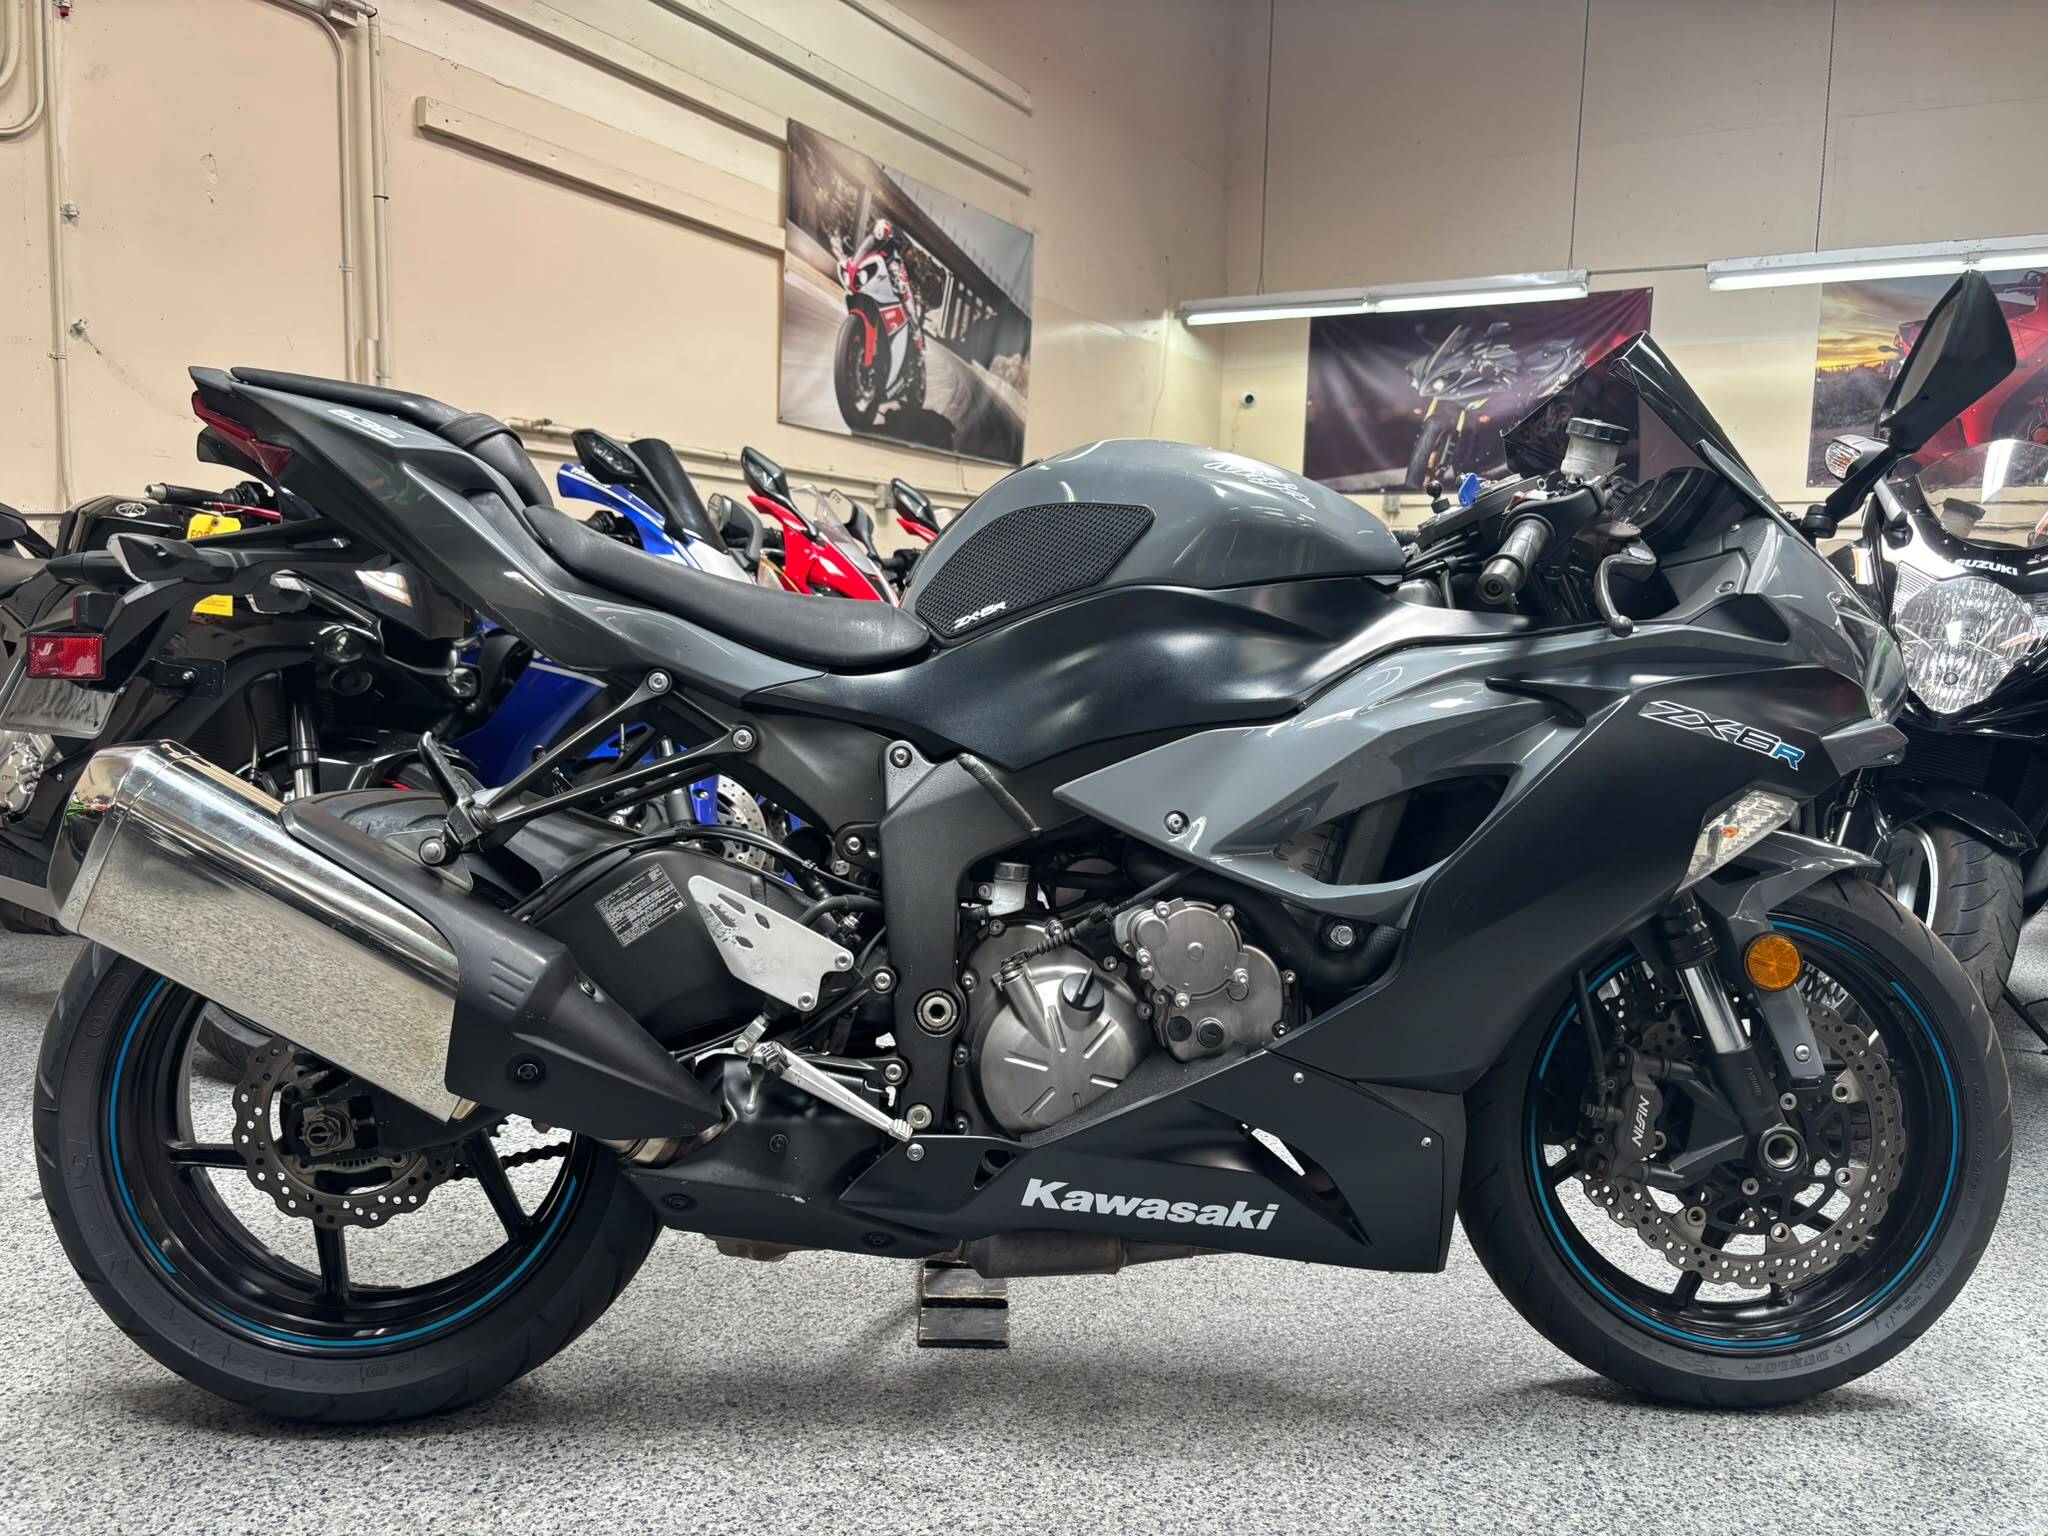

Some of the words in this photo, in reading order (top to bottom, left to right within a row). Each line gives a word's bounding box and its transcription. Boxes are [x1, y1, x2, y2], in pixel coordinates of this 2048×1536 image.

[1954, 558, 2018, 576] SUZUKI
[1638, 700, 1806, 771] ZX-6R
[1021, 1178, 1280, 1230] Kawasaki
